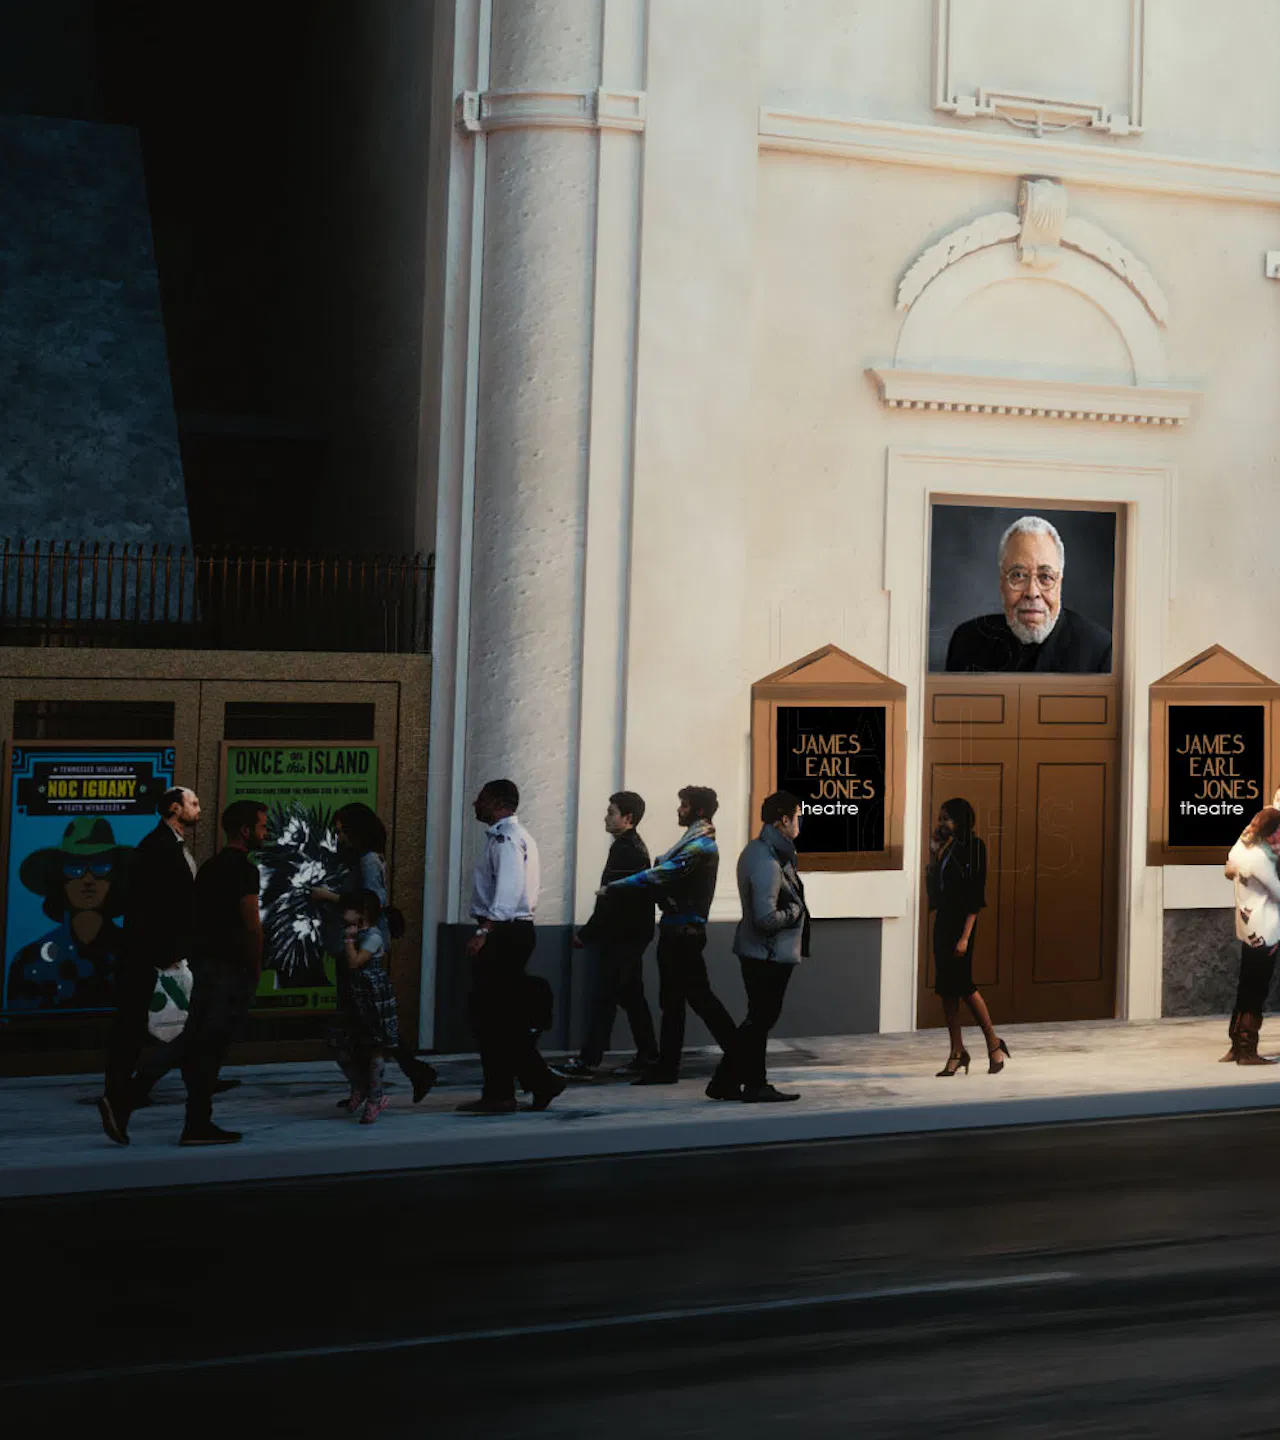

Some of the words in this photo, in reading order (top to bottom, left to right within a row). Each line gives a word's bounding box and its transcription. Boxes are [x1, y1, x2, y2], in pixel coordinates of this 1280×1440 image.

[792, 733, 861, 755] JAMES
[1176, 733, 1245, 755] JAMES
[235, 750, 284, 775] ONCE
[308, 750, 369, 775] ISLAND
[805, 757, 857, 777] EARL
[1189, 757, 1240, 777] EARL
[47, 780, 78, 798] NOC
[82, 779, 137, 798] IGUANY
[810, 779, 875, 799] JONES
[1194, 779, 1259, 799] JONES
[801, 801, 859, 815] heatre
[1179, 801, 1244, 815] theatre
